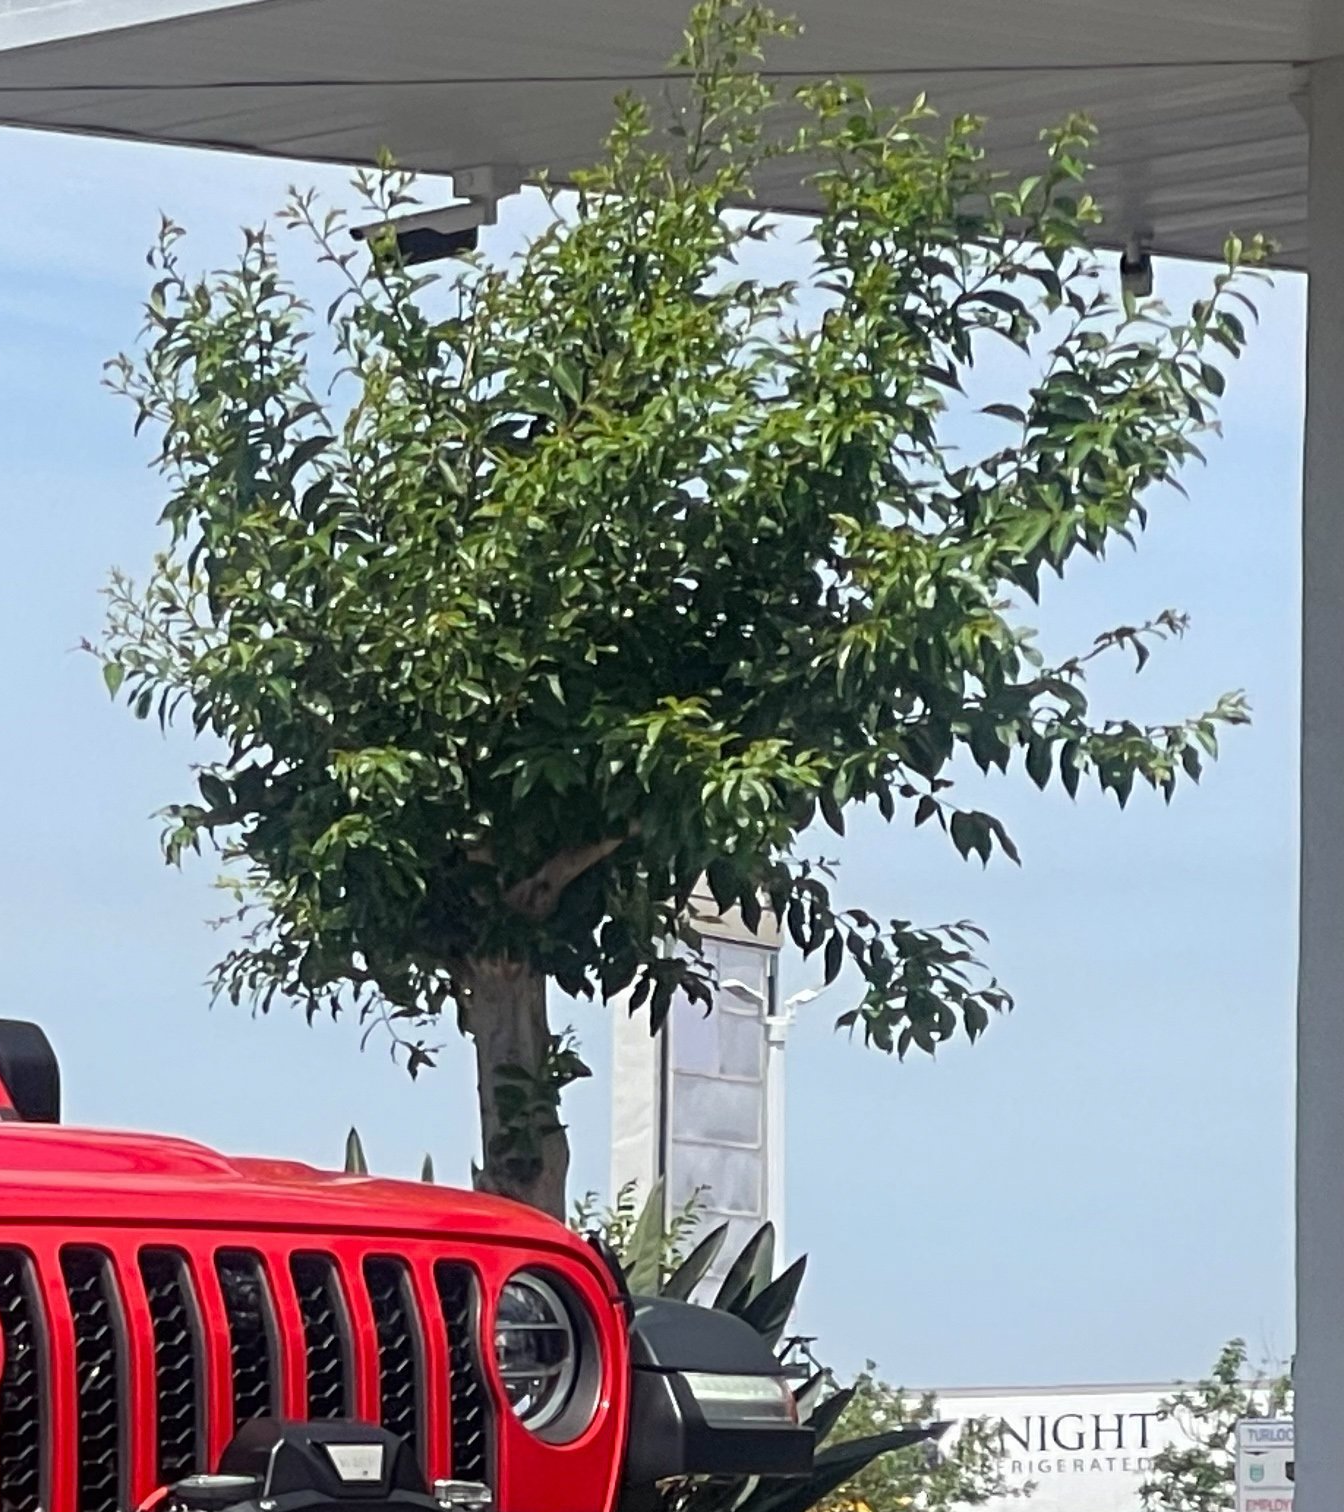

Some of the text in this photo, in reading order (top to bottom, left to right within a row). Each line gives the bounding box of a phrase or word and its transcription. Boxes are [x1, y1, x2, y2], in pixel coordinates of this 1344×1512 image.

[1247, 1427, 1294, 1442] TURLOC
[996, 1457, 1154, 1475] FRIGERATED
[1245, 1499, 1293, 1512] EMPLOY
